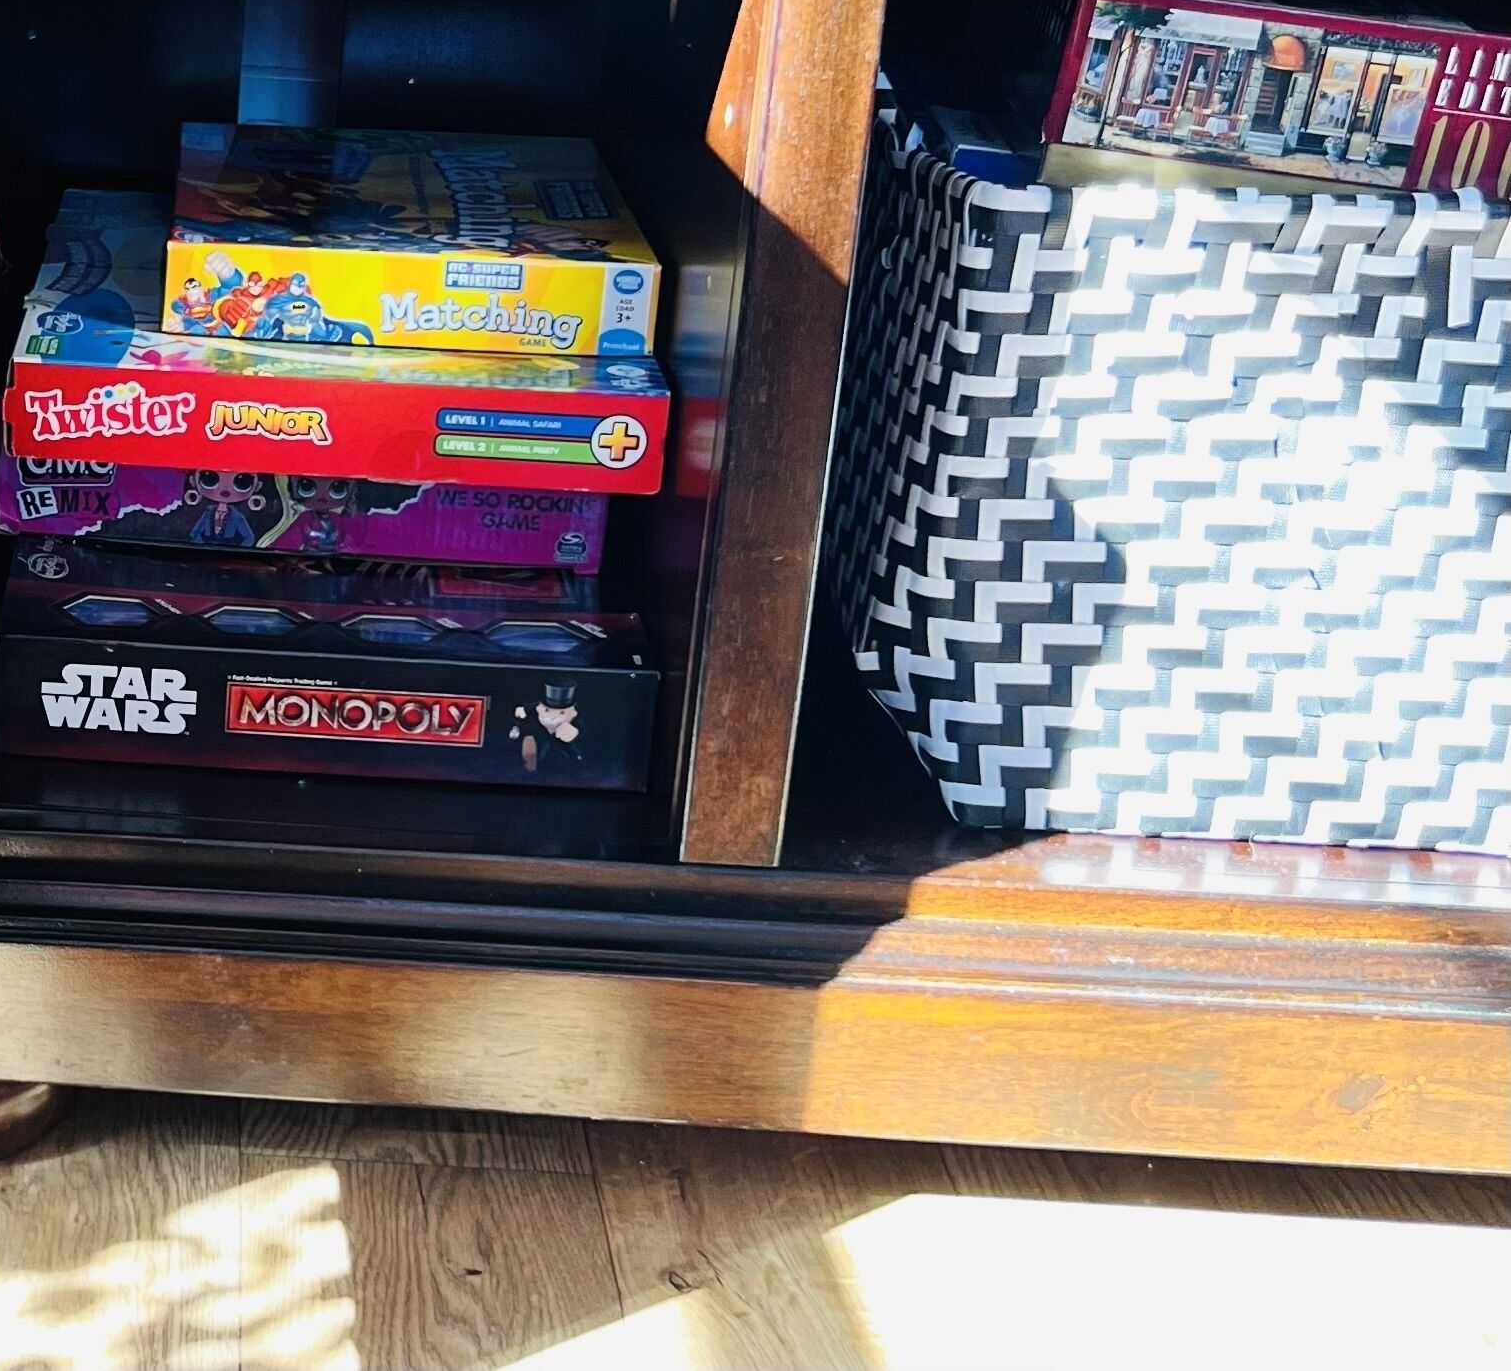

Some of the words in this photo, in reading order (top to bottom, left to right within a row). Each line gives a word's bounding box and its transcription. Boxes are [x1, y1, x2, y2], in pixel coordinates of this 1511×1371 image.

[472, 263, 522, 276] SUPER
[446, 273, 521, 288] FRIENDS
[379, 292, 583, 350] Matching
[616, 313, 631, 323] 3+
[519, 337, 546, 347] GAME
[26, 386, 194, 438] Twister
[207, 402, 329, 442] JUNIOR
[445, 414, 478, 425] LEVEL
[443, 440, 476, 451] LEVEL
[477, 442, 486, 452] 2
[436, 489, 468, 507] WE
[473, 491, 501, 508] SO
[481, 512, 540, 530] GAME
[41, 663, 197, 703] STAR
[41, 694, 197, 734] WARS
[239, 693, 475, 736] MONOPOLY
